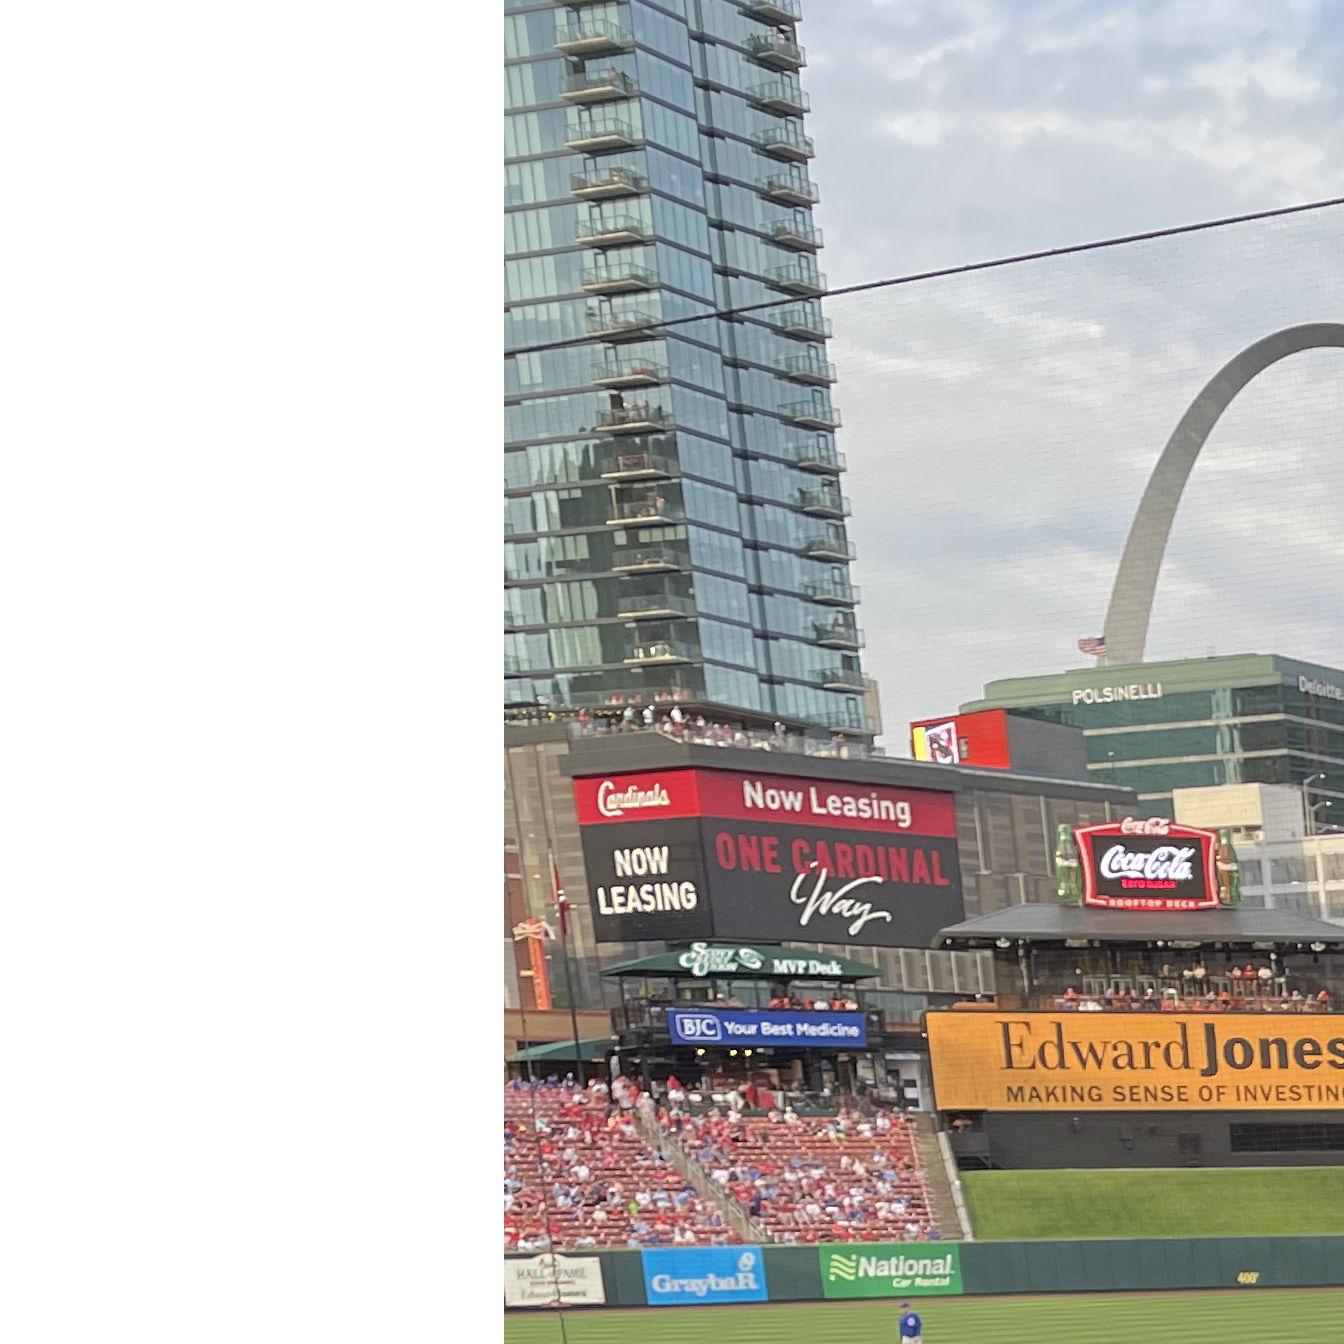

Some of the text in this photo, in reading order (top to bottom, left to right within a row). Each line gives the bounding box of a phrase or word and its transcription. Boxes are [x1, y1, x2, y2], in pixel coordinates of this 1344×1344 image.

[1072, 683, 1163, 705] POLSINELLI
[597, 780, 670, 817] Cardinals
[743, 780, 911, 828] Now Leasing
[614, 846, 669, 877] NOW
[715, 832, 950, 886] ONE CARDINAL
[597, 882, 698, 915] LEASING
[790, 861, 892, 935] Way
[773, 959, 805, 974] MVP
[682, 1019, 861, 1038] BJC Your Best Medicine
[1000, 1021, 1195, 1071] Edward
[1006, 1085, 1101, 1101] MAKING
[1113, 1085, 1189, 1101] SENSE
[1198, 1085, 1226, 1101] OF
[857, 1255, 952, 1279] National
[892, 1276, 950, 1288] Car Rental
